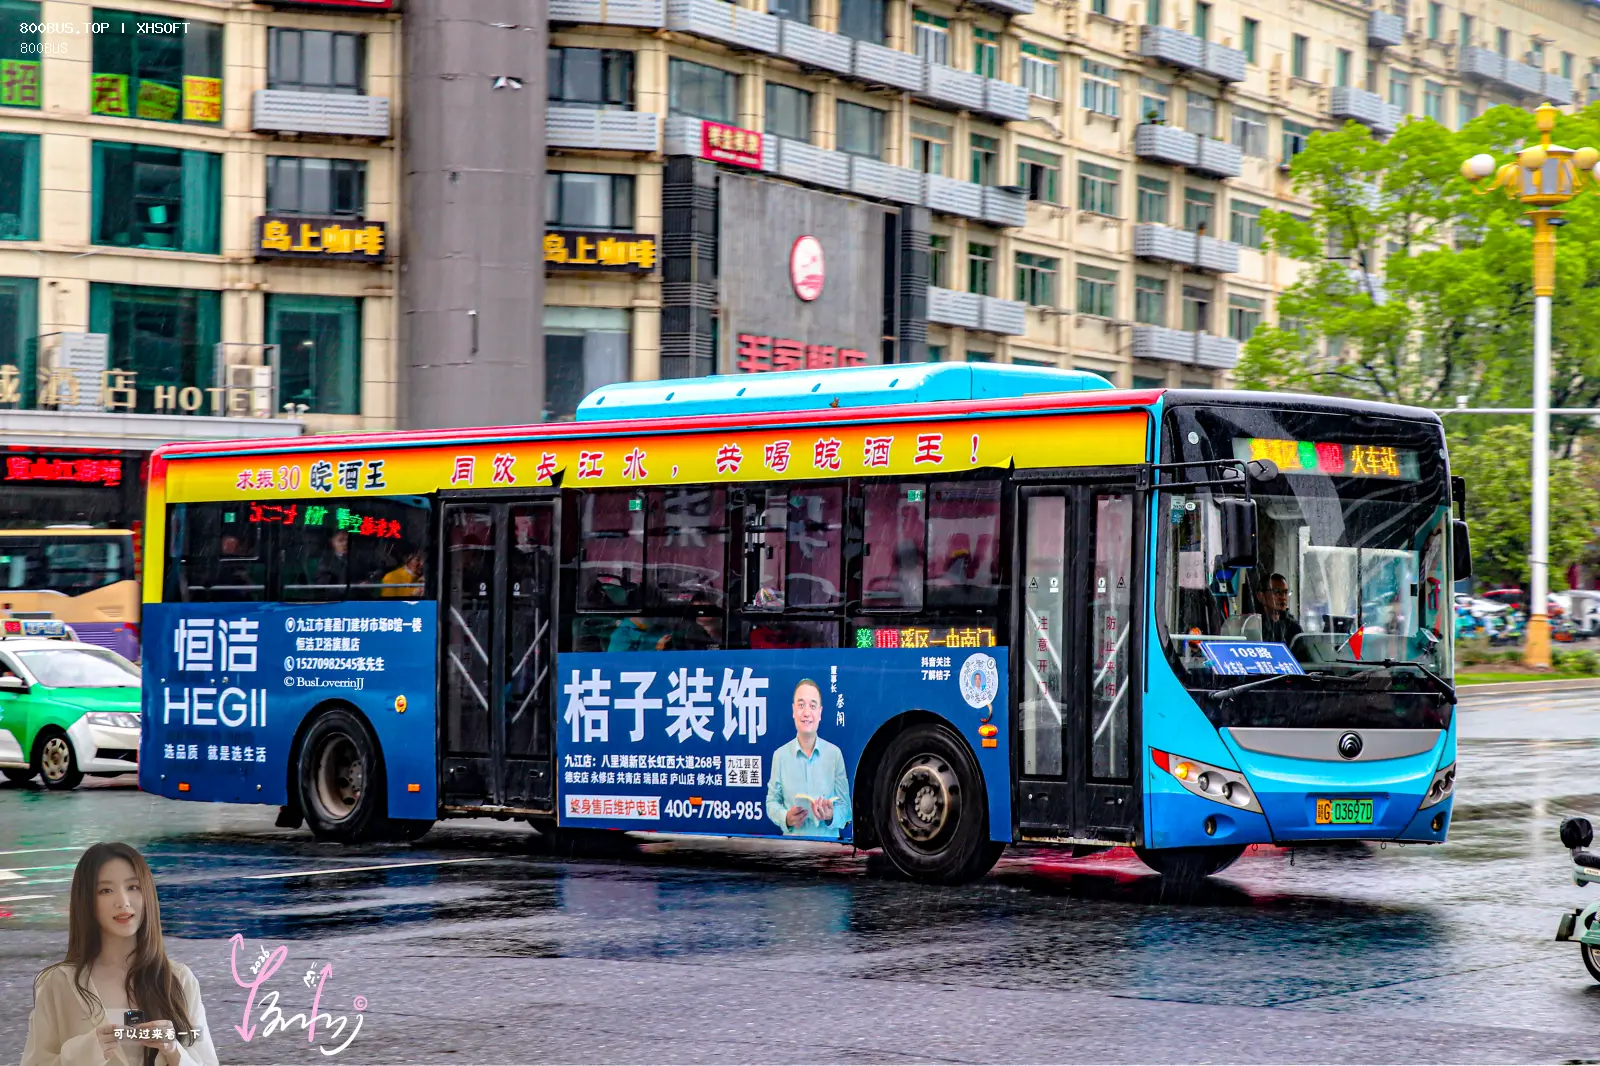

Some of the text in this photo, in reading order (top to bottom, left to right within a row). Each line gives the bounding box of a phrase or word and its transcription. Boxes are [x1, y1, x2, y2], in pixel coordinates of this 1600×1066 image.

[3, 62, 37, 103] 招
[262, 220, 385, 256] 岛上咖啡
[543, 233, 657, 269] 岛上咖啡
[1351, 444, 1400, 477] 火车站
[310, 459, 386, 492] 皖酒王
[296, 617, 422, 633] 九江市喜盈门建材市场B馆一楼
[174, 618, 259, 672] 恒洁
[295, 637, 361, 652] 恒洁卫浴旗舰店
[1229, 647, 1273, 659] 108路
[296, 656, 385, 672] 15270982545张先生
[921, 656, 951, 668] 抖音关注
[1037, 616, 1049, 695] 注意开门
[1105, 616, 1117, 697] 防止夹伤
[921, 669, 951, 681] 了解桔子
[163, 687, 267, 727] HEGII
[564, 667, 769, 744] 桔子装饰
[164, 744, 266, 762] 选品质 就是选生活
[727, 758, 760, 770] 九江县区
[564, 771, 723, 787] 德安店 永修店 共青店 瑞昌店 庐山店 修水店
[728, 770, 760, 785] 全覆盖
[570, 798, 658, 817] 终身售后维护电话
[664, 799, 763, 820] 400-7788-985
